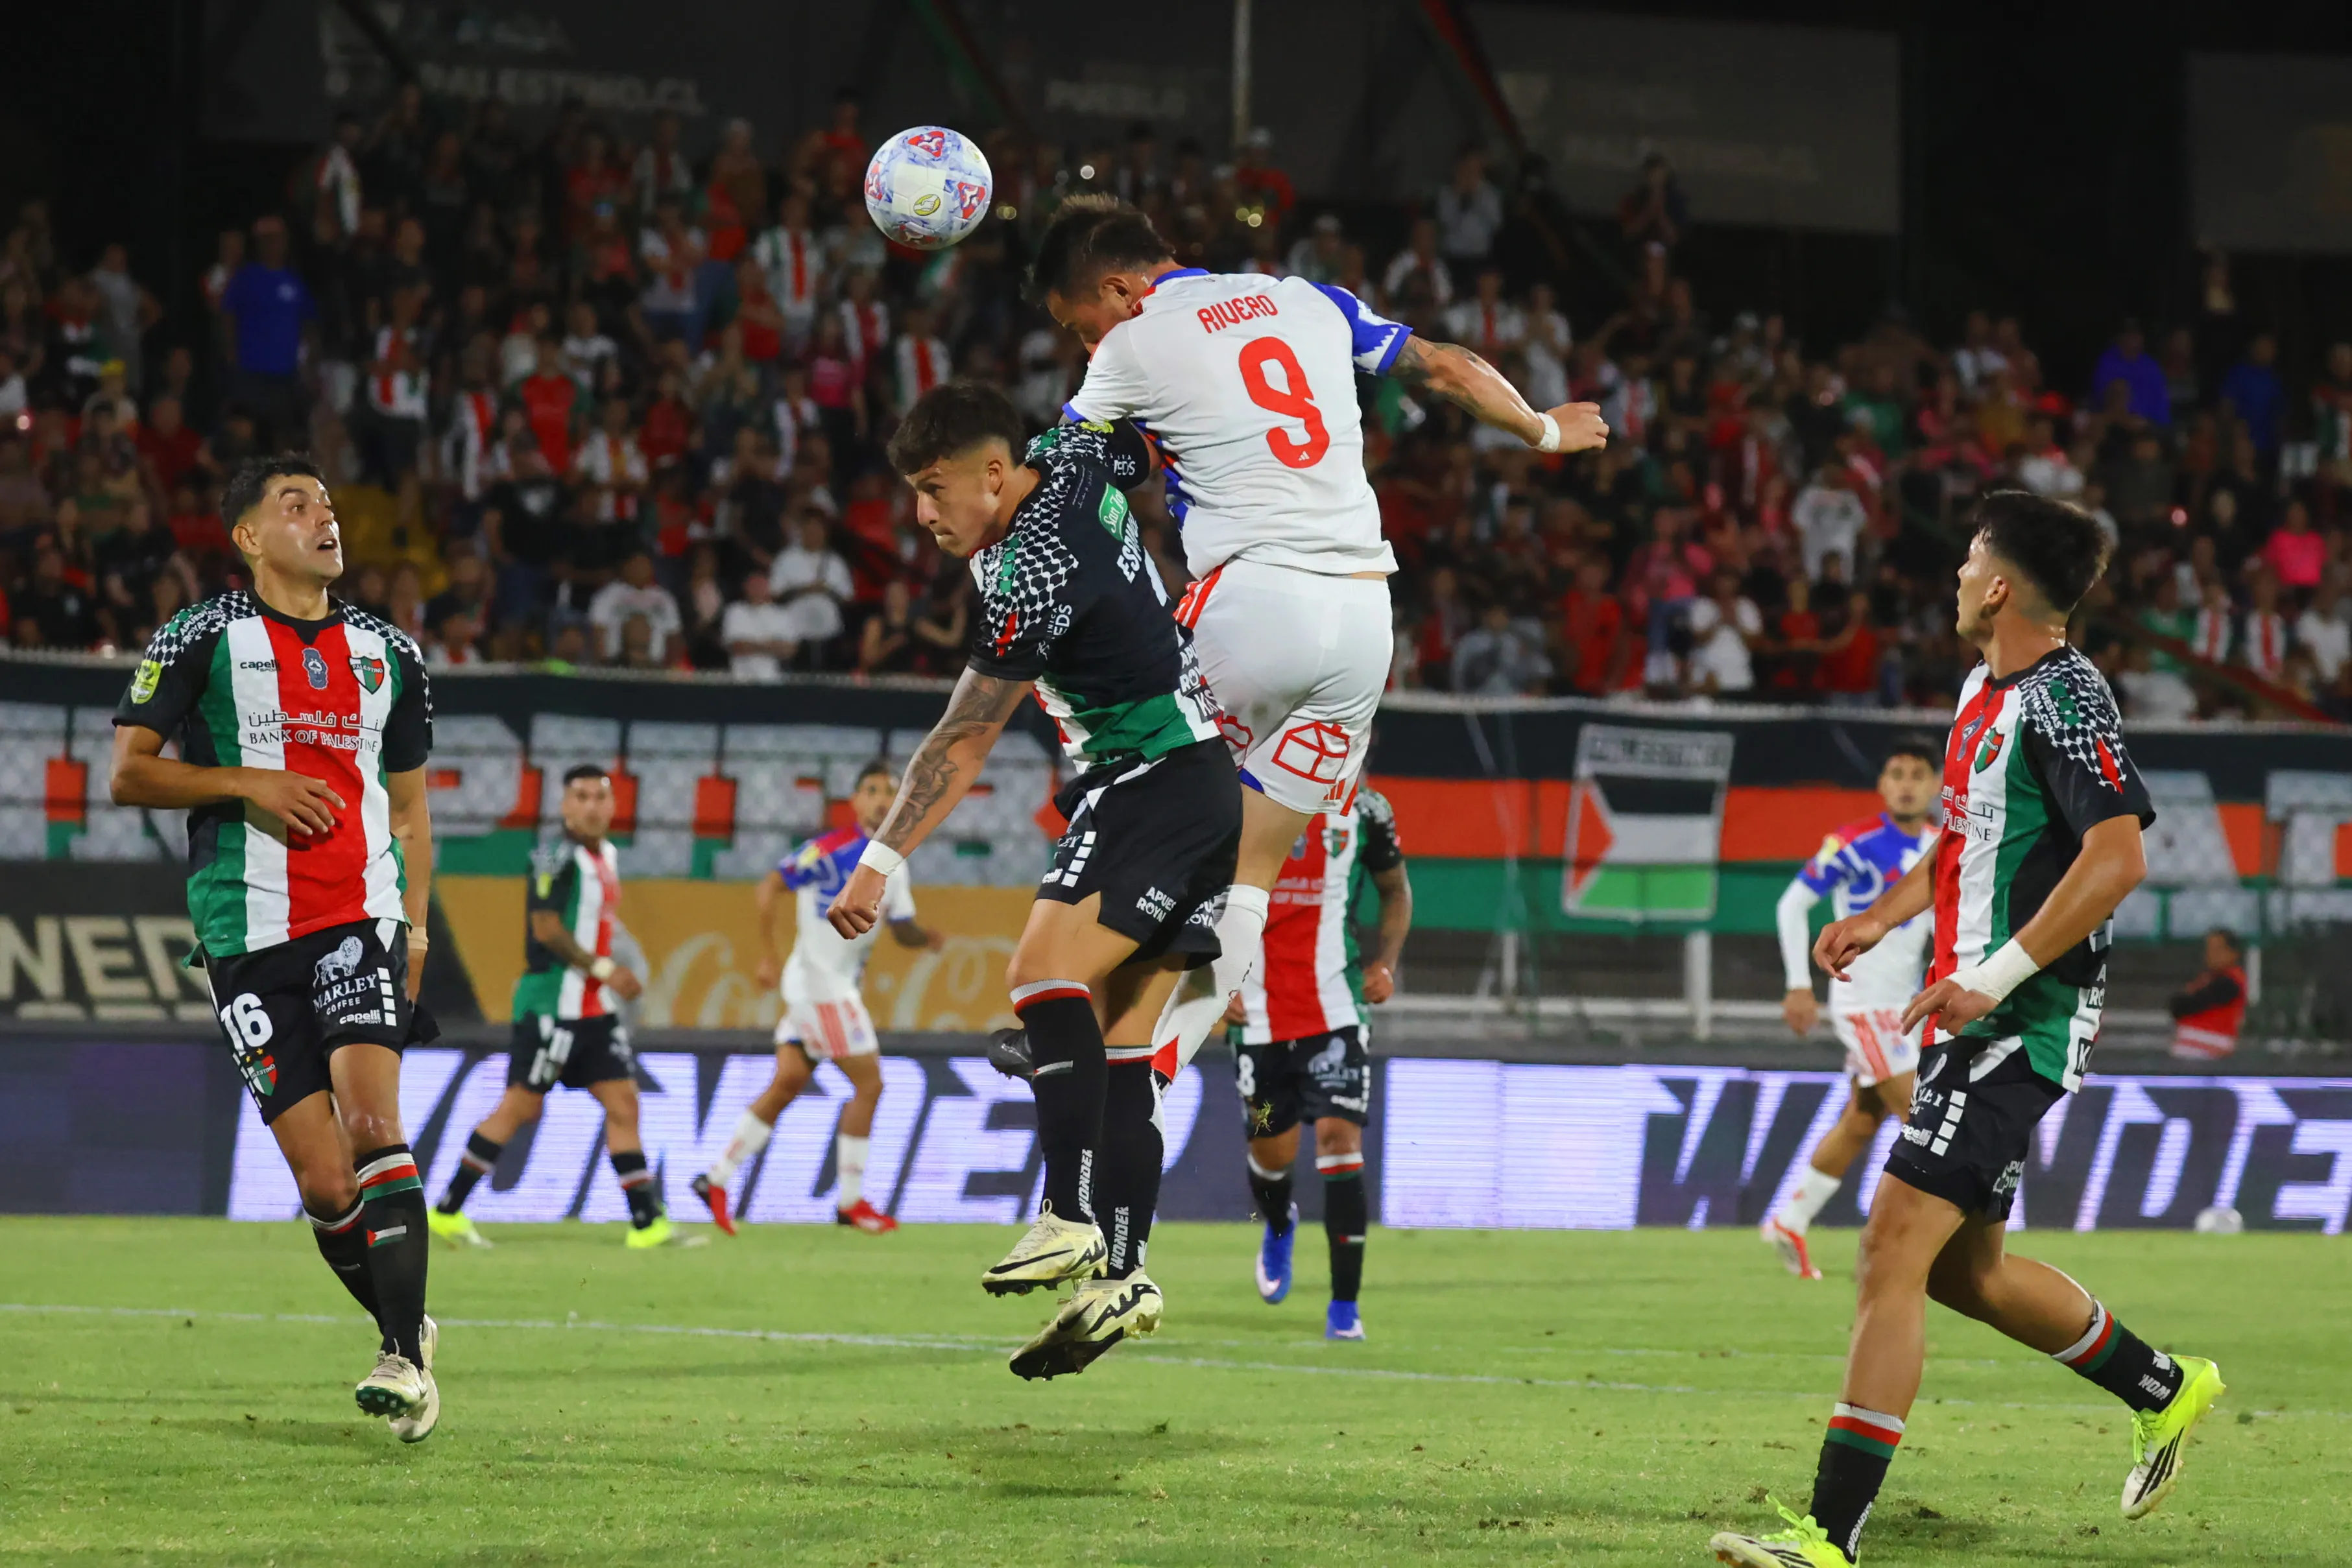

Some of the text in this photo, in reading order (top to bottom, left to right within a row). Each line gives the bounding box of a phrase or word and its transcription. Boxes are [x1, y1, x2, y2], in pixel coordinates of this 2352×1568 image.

[1197, 294, 1278, 334] RIVERO
[1238, 336, 1330, 469] 9
[1053, 604, 1073, 636] EDS
[248, 709, 337, 727] فلسطين
[250, 729, 378, 753] BANK OF PALESTINE
[313, 973, 378, 1014] MARLEY
[326, 997, 361, 1016] COFFEE
[220, 992, 274, 1056] 16
[339, 1009, 381, 1025] capelli
[1109, 1206, 1129, 1270] WONDER
